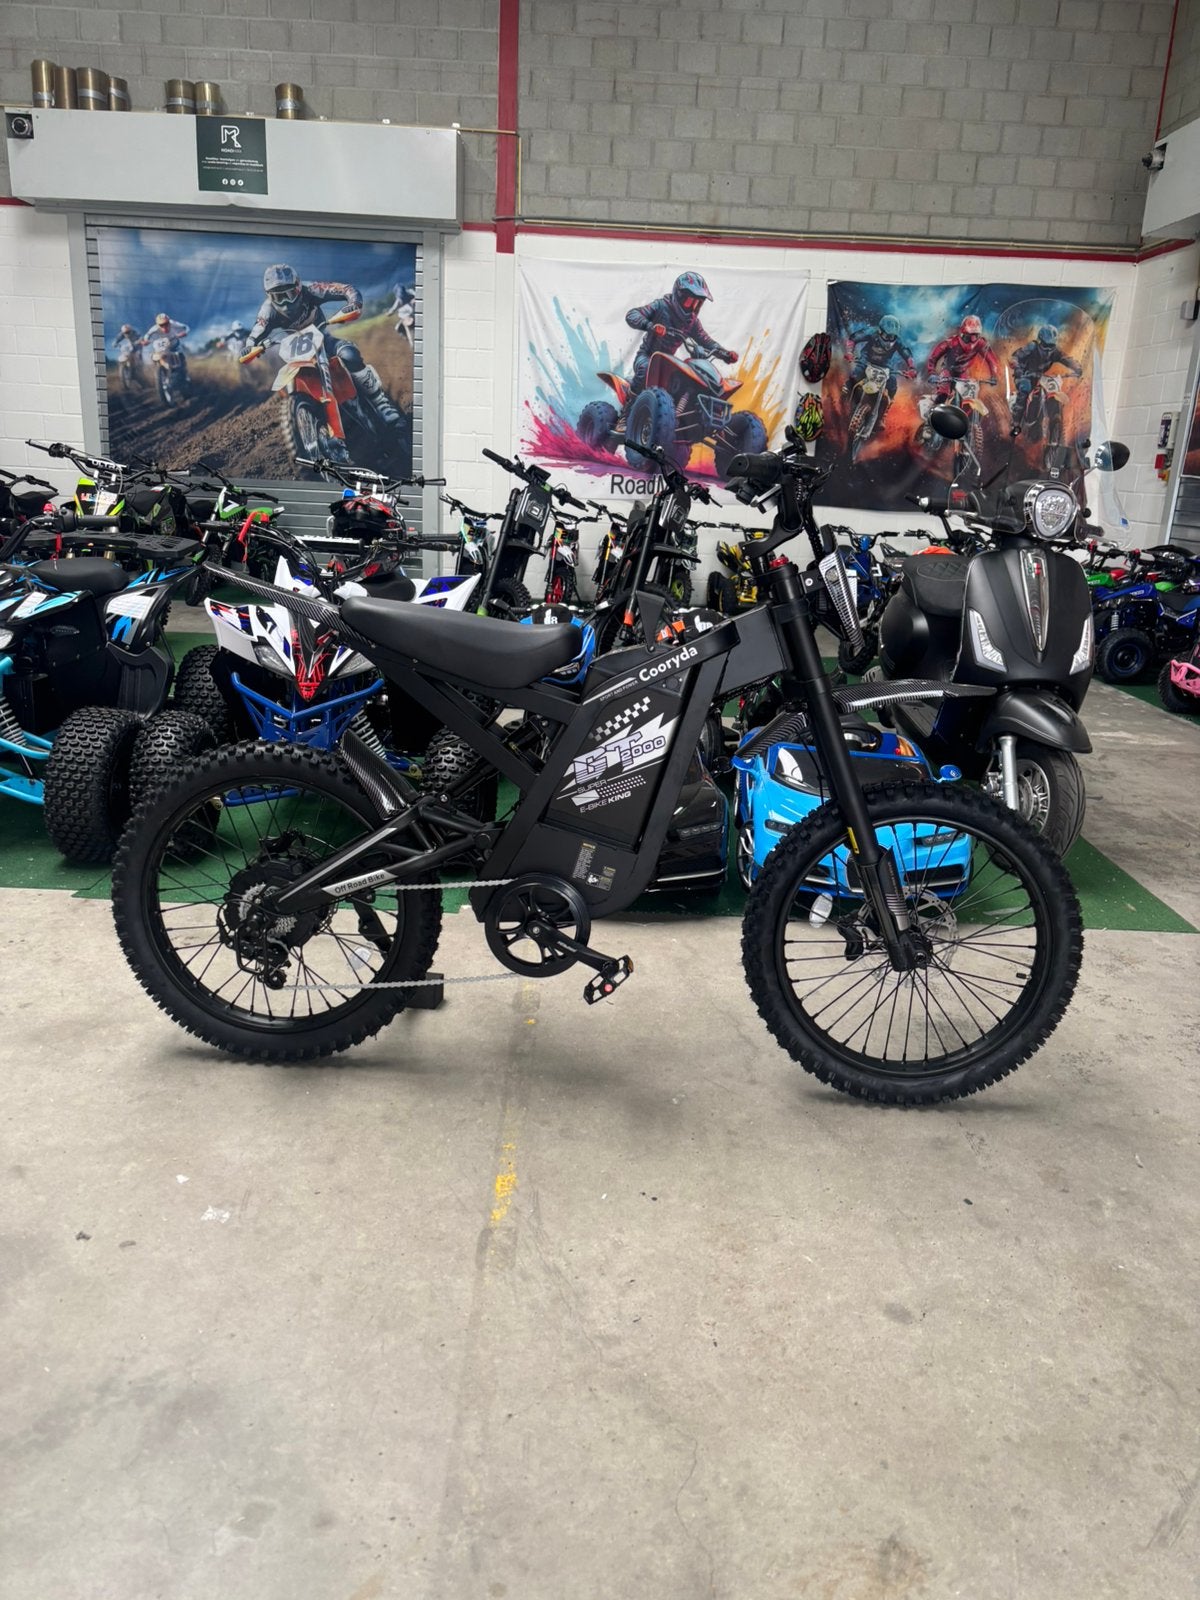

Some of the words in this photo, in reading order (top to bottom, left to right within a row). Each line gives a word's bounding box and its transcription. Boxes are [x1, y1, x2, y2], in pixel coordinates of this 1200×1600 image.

[610, 473, 668, 495] RoadM
[638, 646, 698, 682] Cooryda
[577, 779, 607, 793] SUPER
[580, 797, 607, 813] E-BIKE
[608, 790, 632, 804] KING
[334, 885, 347, 894] Off
[347, 878, 367, 889] Road
[367, 873, 385, 883] Bike
